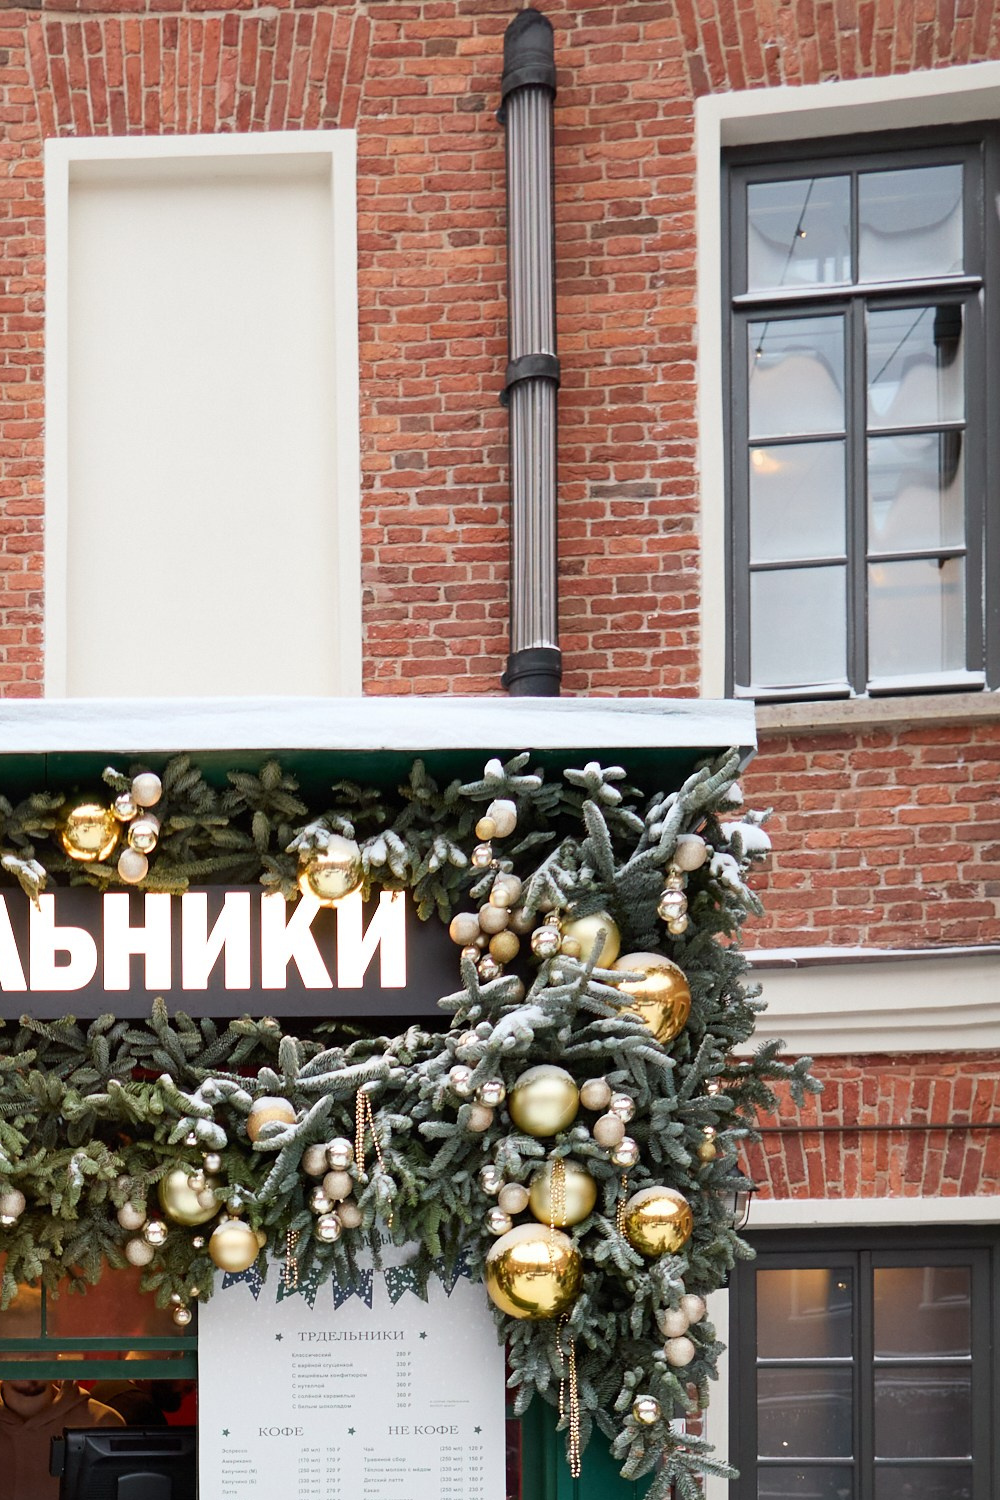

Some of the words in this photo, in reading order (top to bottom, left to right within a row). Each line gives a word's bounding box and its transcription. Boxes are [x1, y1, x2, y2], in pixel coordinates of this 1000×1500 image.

[297, 1330, 404, 1343] ТРДЕЛЬНИКИ
[258, 1426, 304, 1437] КОФЕ
[388, 1426, 410, 1435] НЕ
[414, 1425, 459, 1435] КОФЕ
